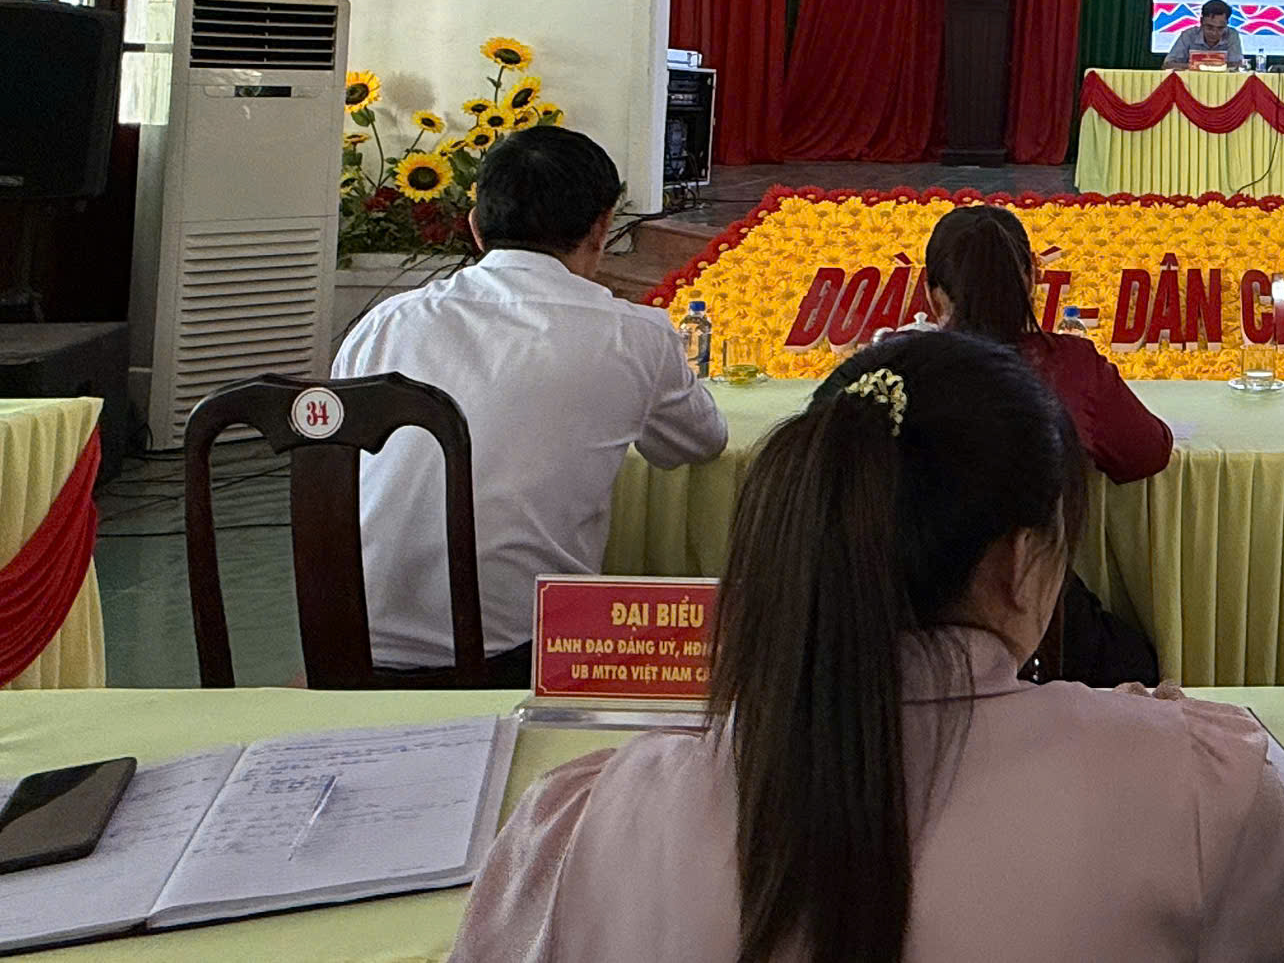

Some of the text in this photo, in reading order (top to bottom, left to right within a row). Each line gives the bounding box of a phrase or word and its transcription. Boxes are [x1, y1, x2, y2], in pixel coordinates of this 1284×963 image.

[1110, 253, 1222, 349] DÂN
[612, 595, 704, 632] ĐẠI BIỂU
[547, 636, 582, 653] LÃNH
[586, 639, 614, 656] ĐẠO
[617, 636, 655, 654] ĐẢNG
[572, 665, 589, 679] UB
[592, 665, 628, 680] MTTQ
[631, 663, 659, 685] VIỆT
[662, 666, 691, 681] NAM
